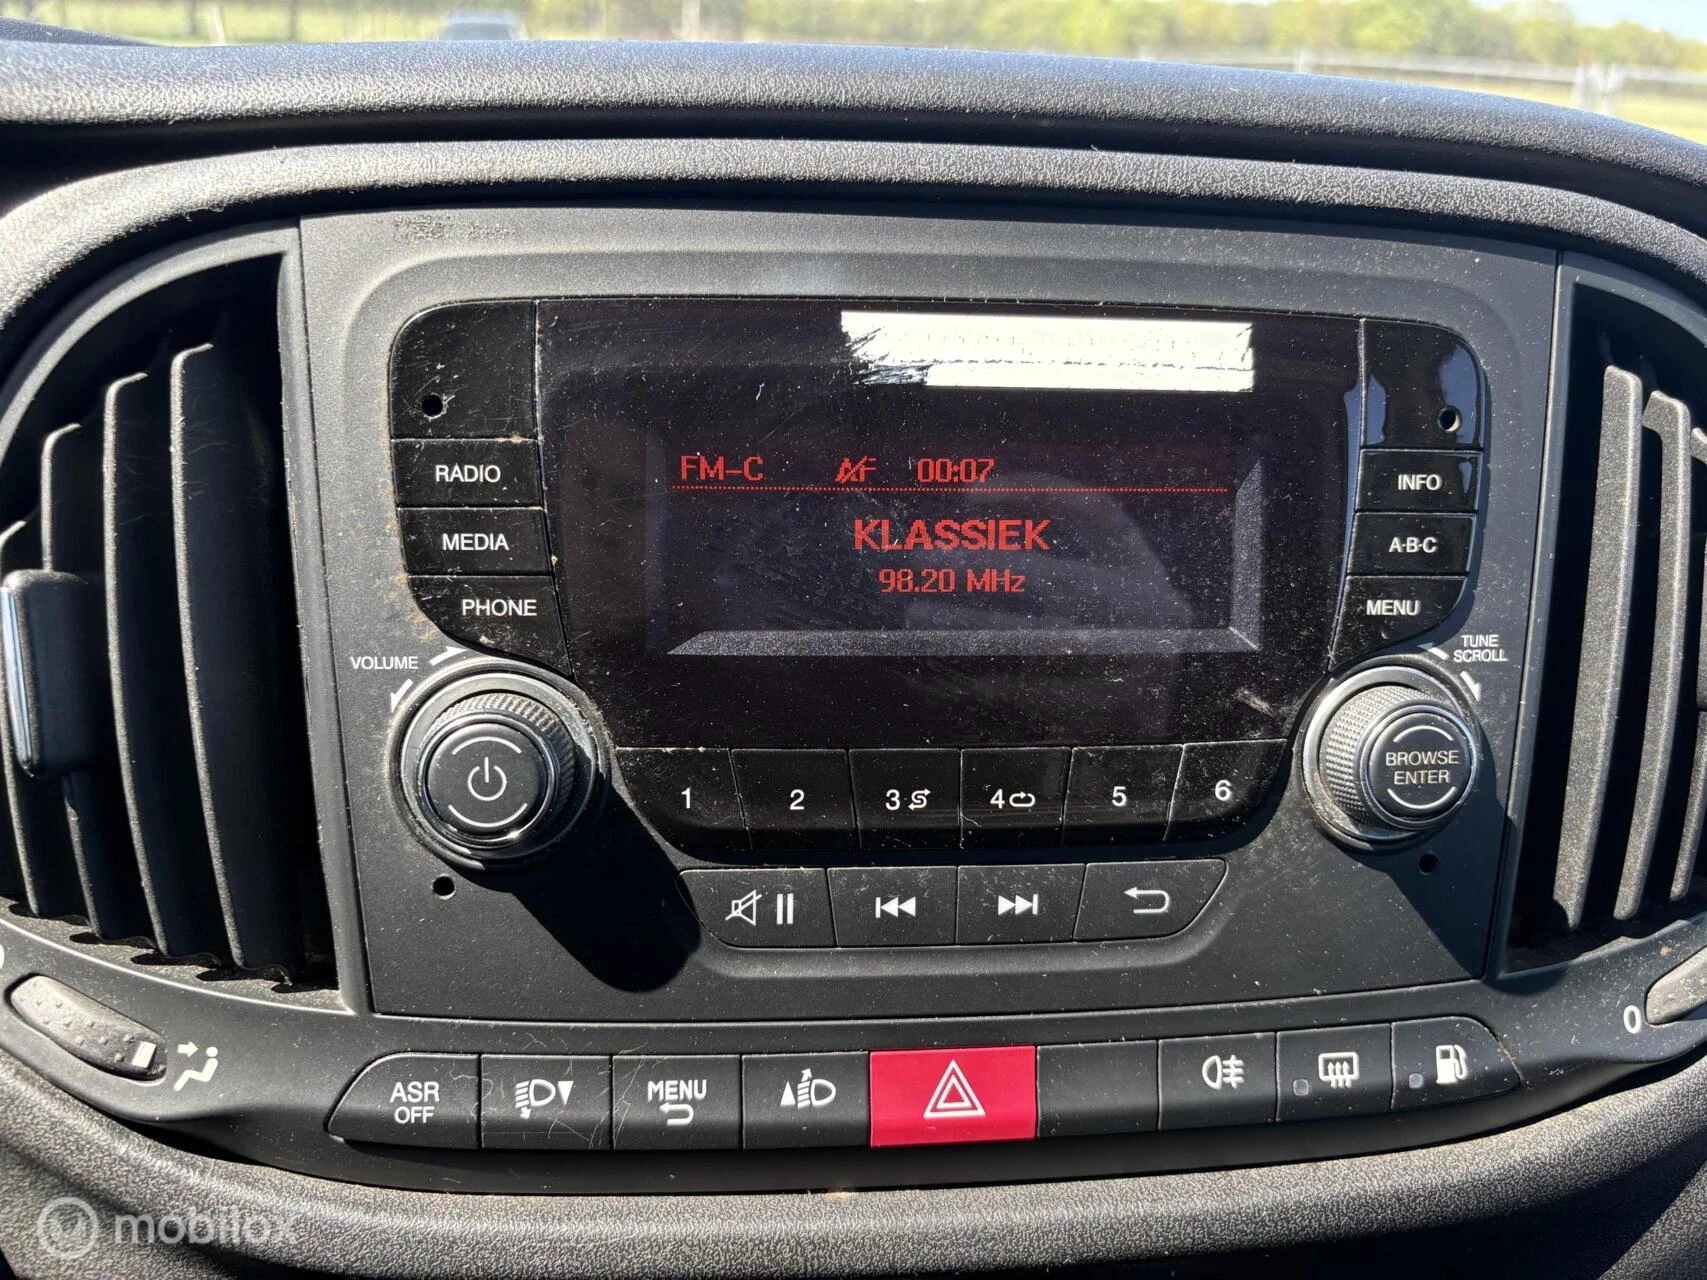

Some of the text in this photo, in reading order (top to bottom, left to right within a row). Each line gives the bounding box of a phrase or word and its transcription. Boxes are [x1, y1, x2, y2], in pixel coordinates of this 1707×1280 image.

[434, 464, 501, 484] RADIO
[680, 455, 764, 481] FM-C
[916, 458, 995, 483] 00:07
[1397, 474, 1442, 491] INFO
[441, 533, 509, 551] MEDIA
[854, 519, 1050, 551] KLASSIEK
[878, 569, 1025, 593] 98.20 MHz
[461, 598, 538, 617] PHONE
[1366, 599, 1420, 616] MENU
[1461, 635, 1499, 648] TUNE
[350, 655, 419, 671] VOLUME
[1453, 649, 1507, 663] SCROLL
[1385, 750, 1460, 767] BROWSE
[1393, 769, 1450, 786] ENTER
[681, 788, 693, 810] 1
[789, 789, 805, 811] 2
[885, 789, 901, 811] 3
[990, 788, 1005, 809] 4
[1112, 787, 1127, 807] 5
[1214, 780, 1231, 802] 6
[1623, 1005, 1642, 1034] 0
[390, 1081, 440, 1103] ASR
[647, 1079, 707, 1100] MENU
[393, 1105, 435, 1125] OFF
